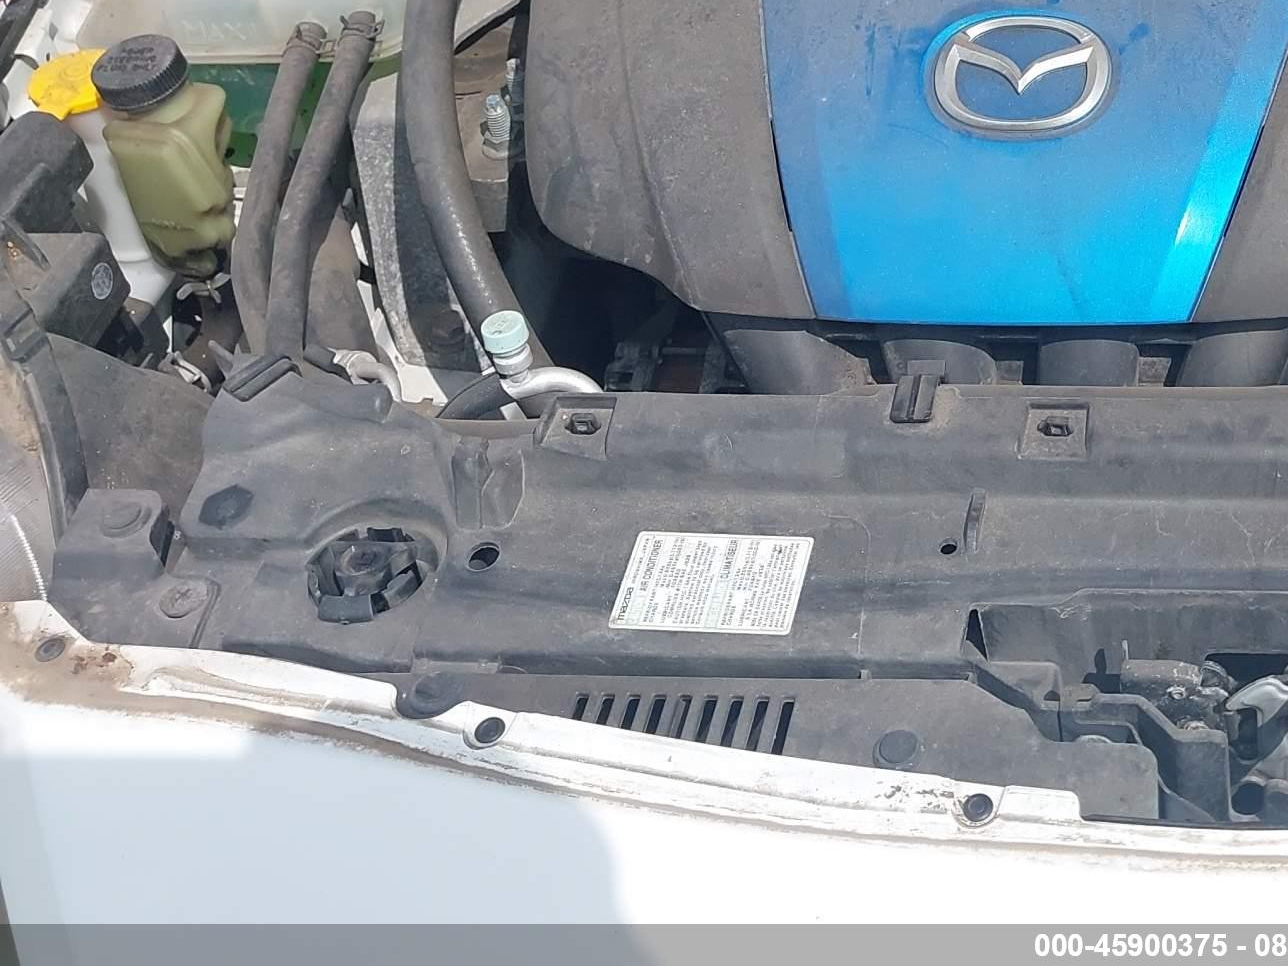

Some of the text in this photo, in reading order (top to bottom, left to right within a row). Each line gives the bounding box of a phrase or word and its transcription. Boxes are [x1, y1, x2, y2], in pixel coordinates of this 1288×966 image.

[637, 538, 663, 591] AIR CONDITIONER
[719, 539, 739, 579] CLIMATISEUR
